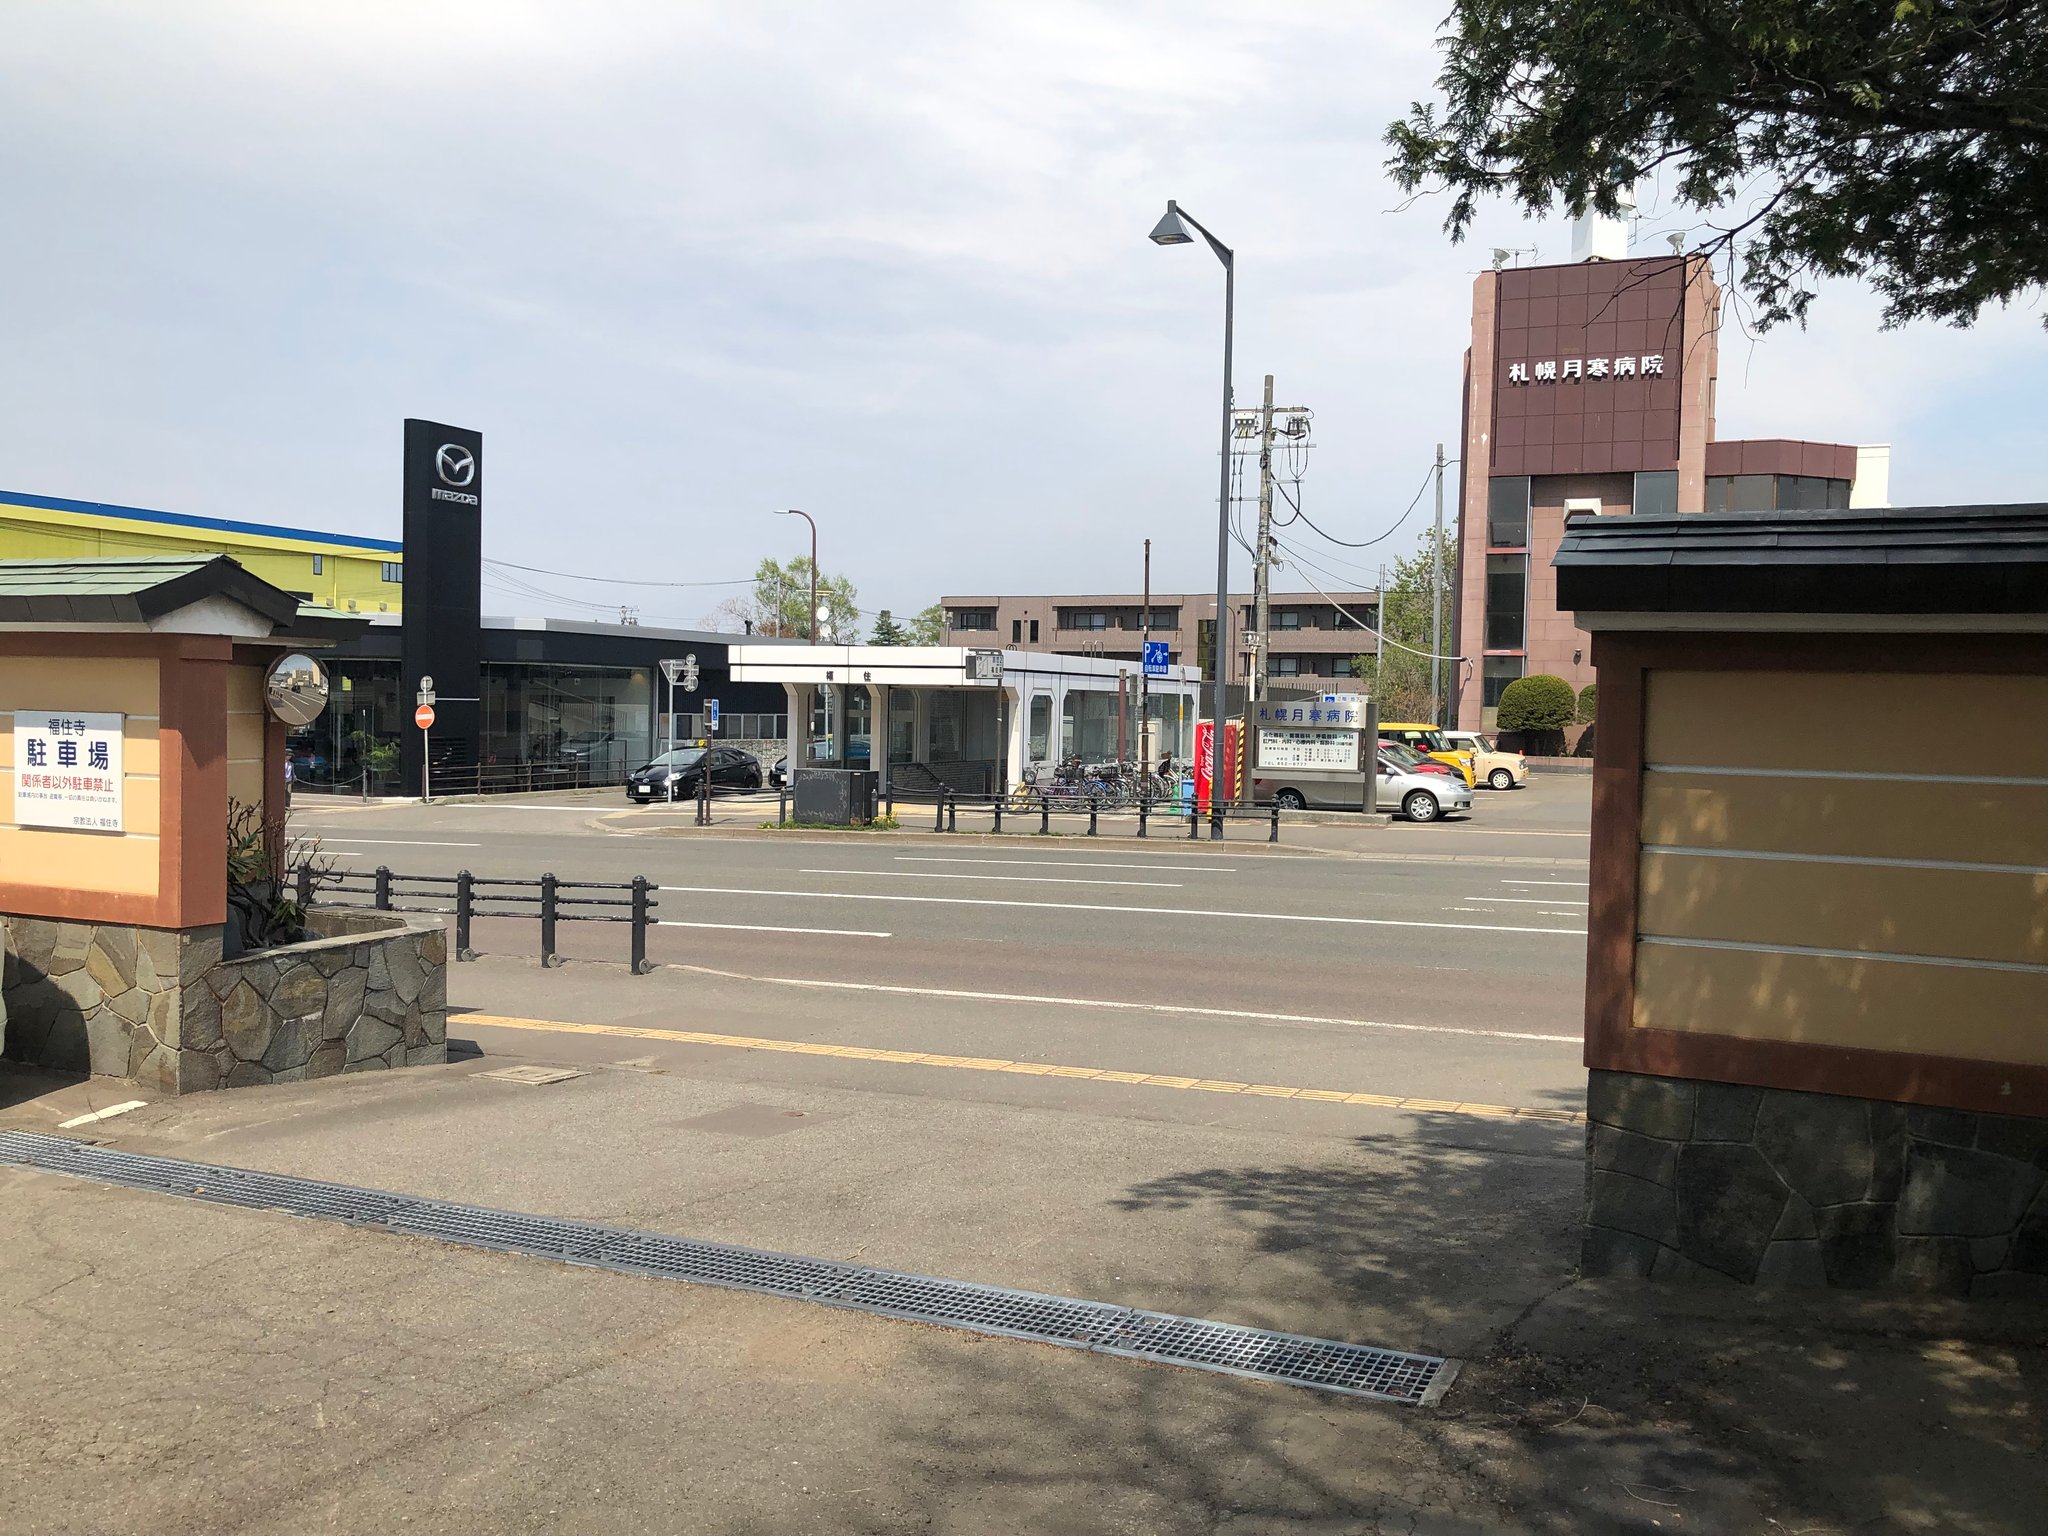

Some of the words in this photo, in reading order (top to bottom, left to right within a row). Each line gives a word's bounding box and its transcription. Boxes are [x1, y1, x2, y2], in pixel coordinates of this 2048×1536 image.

[1508, 354, 1665, 382] 札幌月寒病院
[1144, 642, 1151, 662] P
[826, 670, 872, 682] 福住
[1260, 707, 1358, 723] 札幌月寒病院
[48, 718, 86, 737] 福住寺
[27, 738, 109, 771] 駐車場
[21, 773, 114, 792] 関係者以外駐車禁止
[73, 816, 98, 827] 宗教法人
[100, 818, 118, 827] 福住寺
